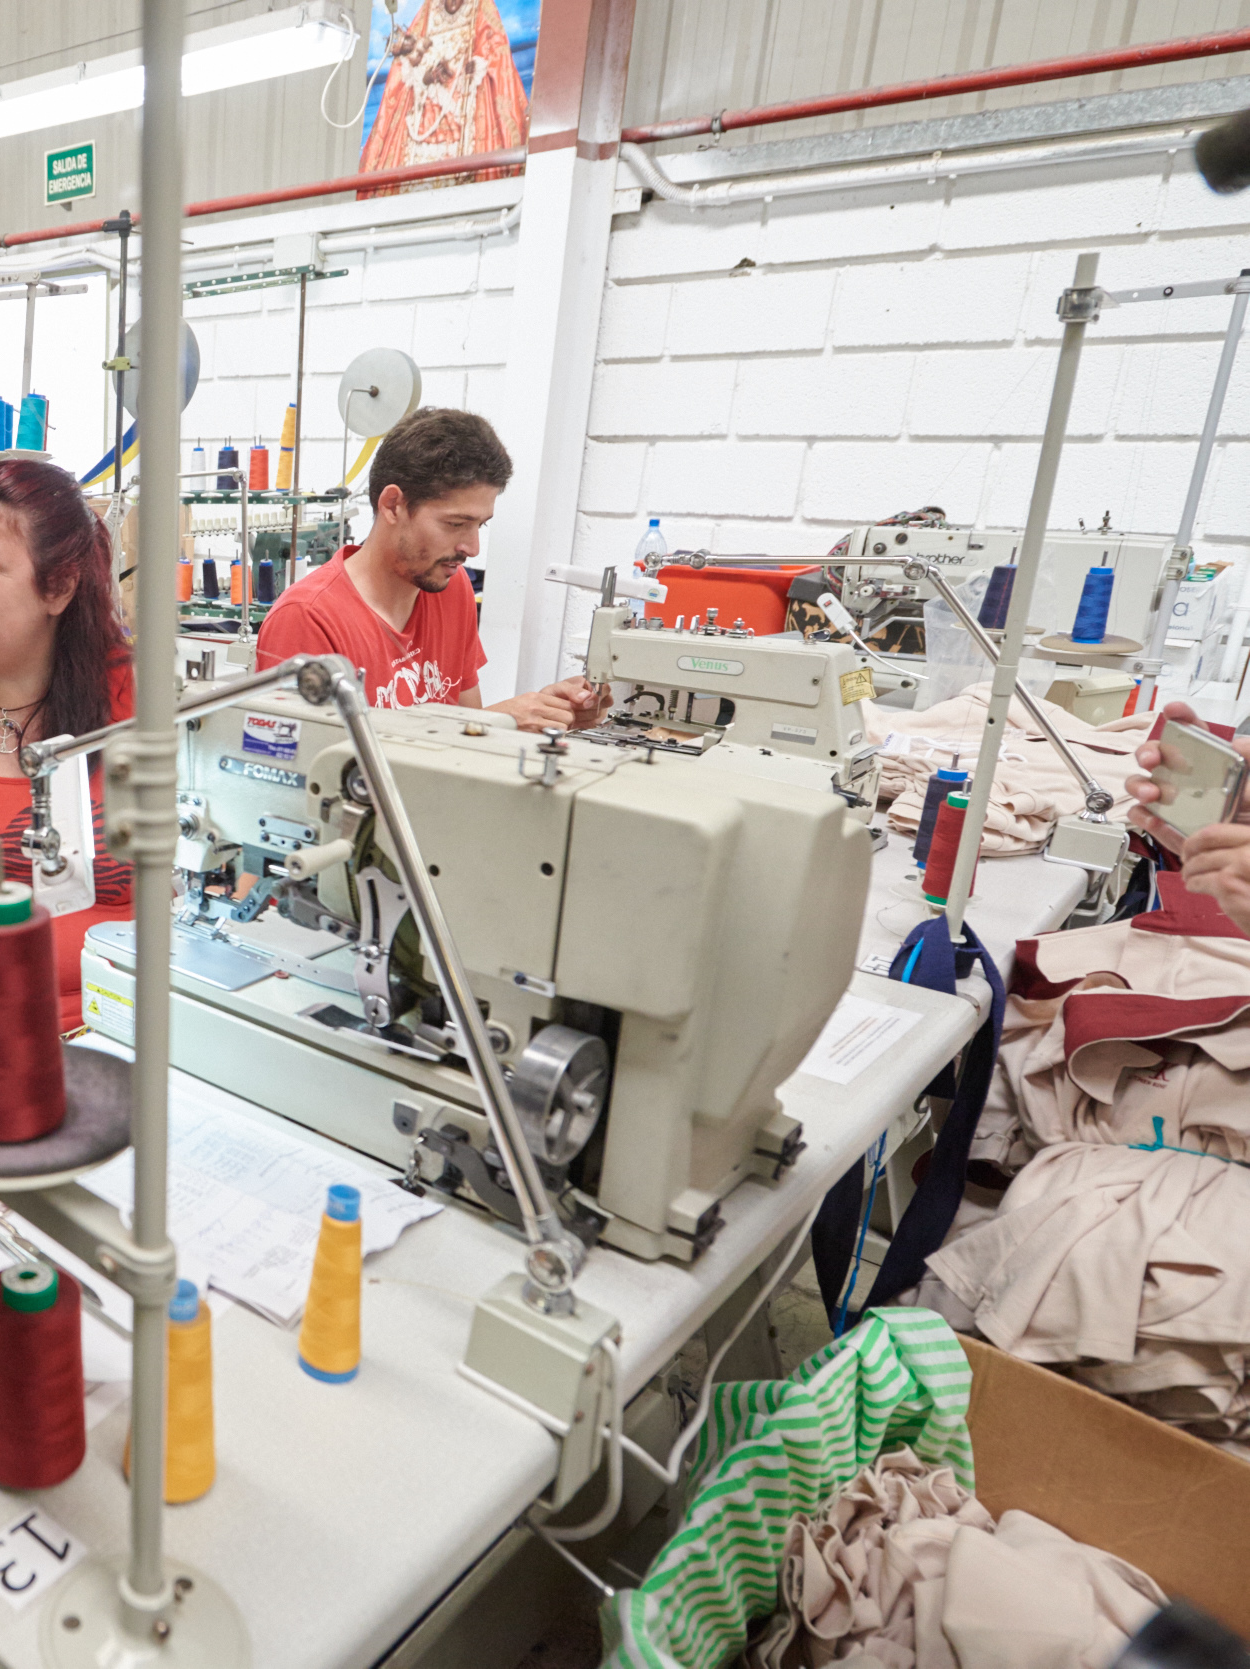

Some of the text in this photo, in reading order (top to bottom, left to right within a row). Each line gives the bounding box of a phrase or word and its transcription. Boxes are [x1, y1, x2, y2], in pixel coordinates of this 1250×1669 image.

[52, 153, 87, 175] SALIDA DE
[48, 172, 92, 195] EMERGENCIA
[691, 657, 729, 671] Venus
[243, 762, 298, 786] FOMAX
